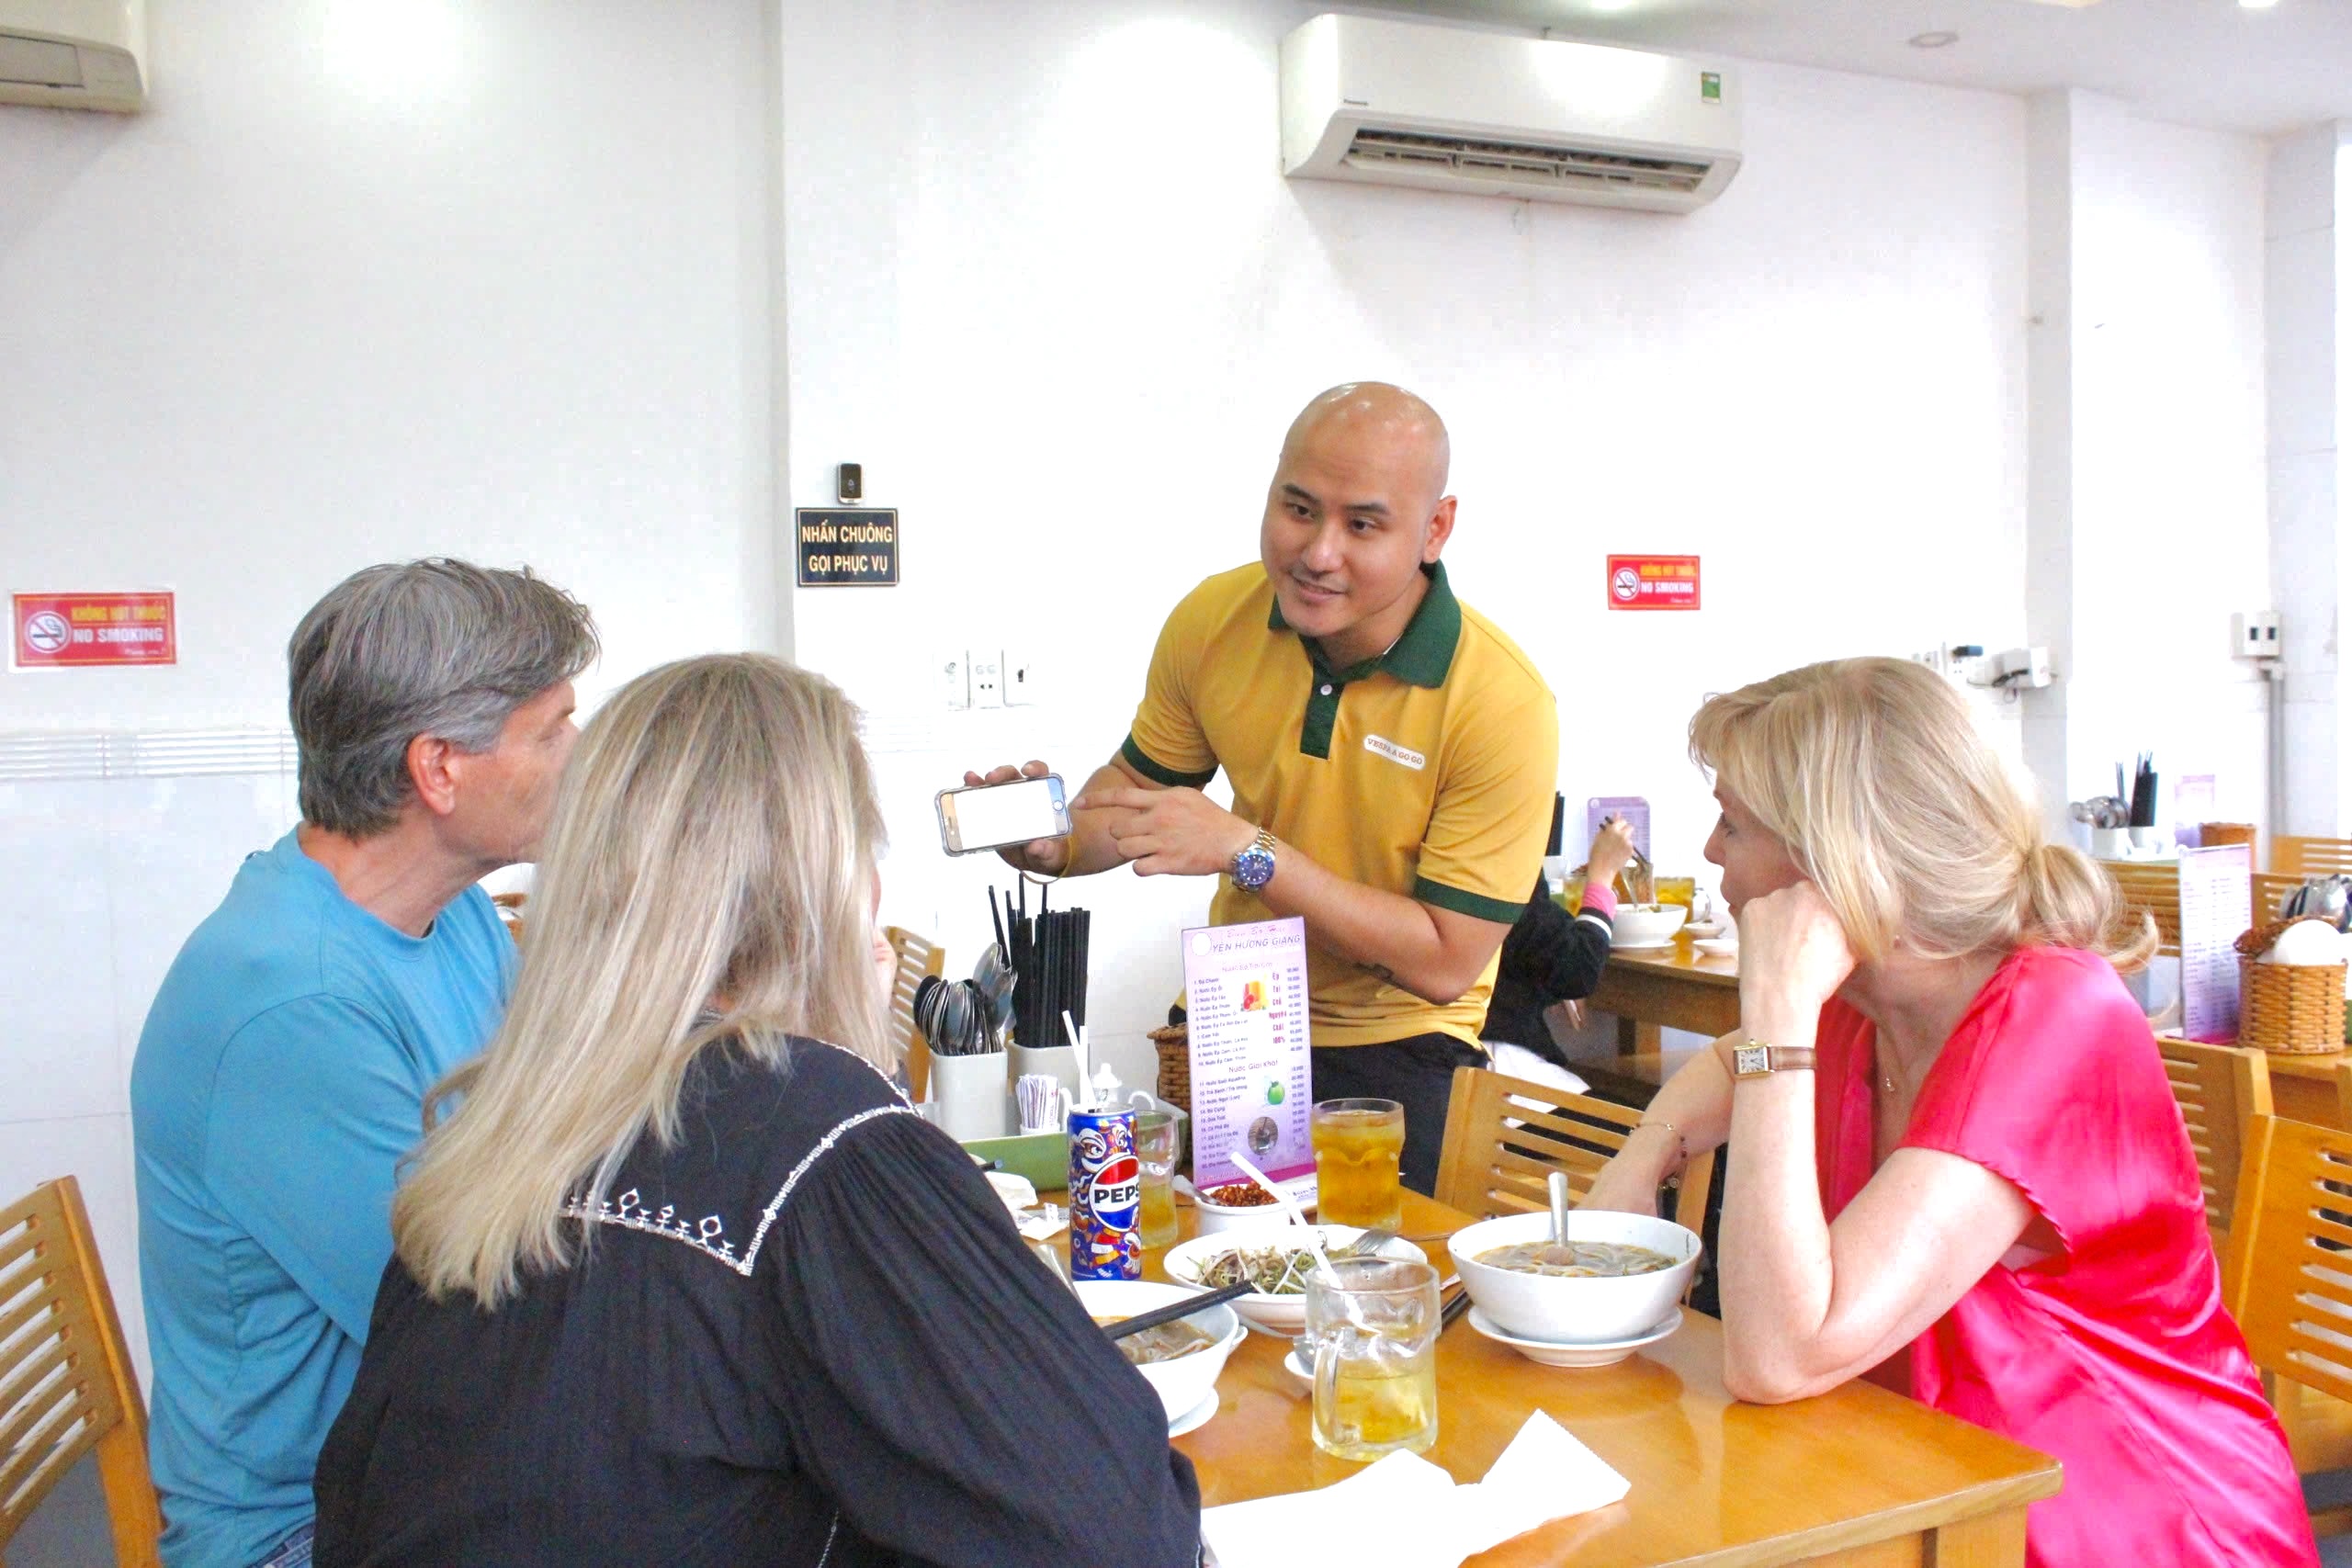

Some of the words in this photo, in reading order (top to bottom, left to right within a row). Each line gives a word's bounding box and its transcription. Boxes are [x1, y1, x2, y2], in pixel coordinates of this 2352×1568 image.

[802, 519, 837, 543] NHẤN
[840, 522, 893, 543] CHUÔNG
[808, 555, 831, 575] GỌI
[834, 555, 868, 575] PHỤC
[871, 555, 888, 575] VỤ
[1641, 581, 1653, 593] NO
[1655, 581, 1693, 593] SMOKING
[73, 628, 94, 643] NO
[97, 626, 164, 643] SMOKING
[1367, 739, 1391, 753] VESPA
[1398, 751, 1410, 761] GO
[1410, 756, 1422, 765] GO
